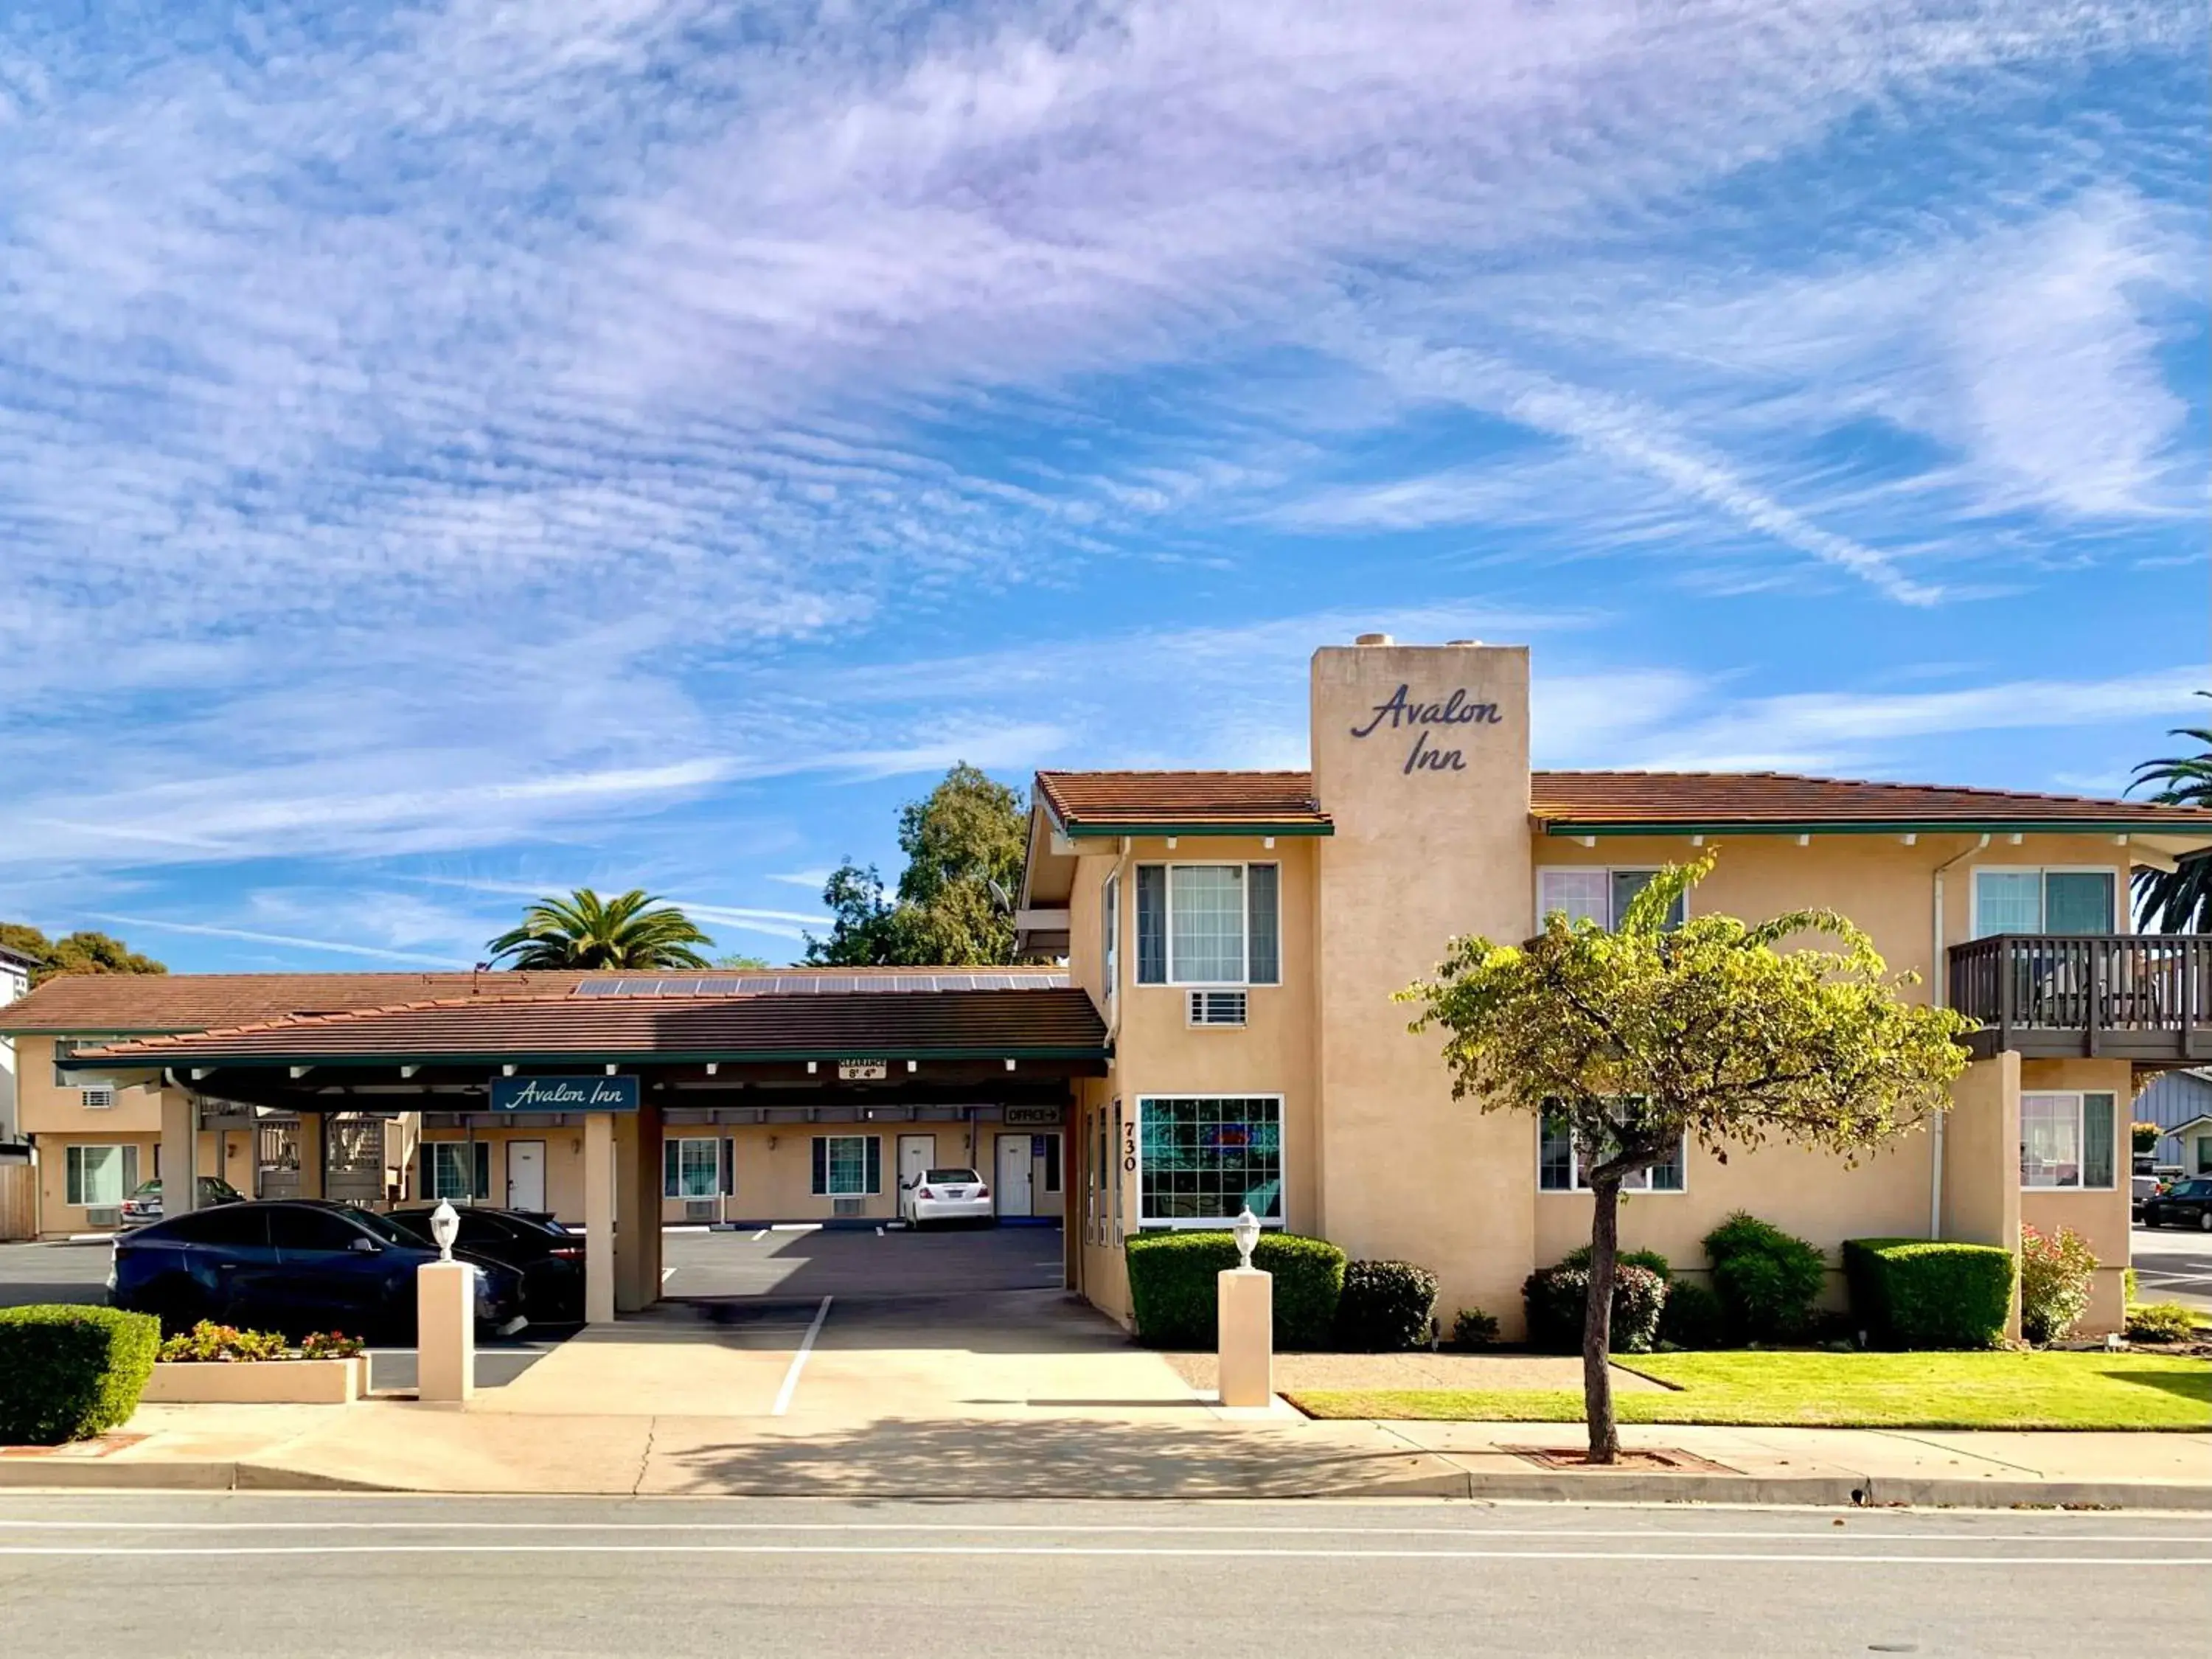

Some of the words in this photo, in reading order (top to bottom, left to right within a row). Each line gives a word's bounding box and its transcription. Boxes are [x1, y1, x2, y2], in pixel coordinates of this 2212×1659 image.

[1350, 684, 1503, 737] Avalon
[1404, 730, 1467, 774] Inn
[505, 1080, 585, 1109] Avalon
[589, 1079, 624, 1104] Inn
[1124, 1121, 1136, 1172] 730
